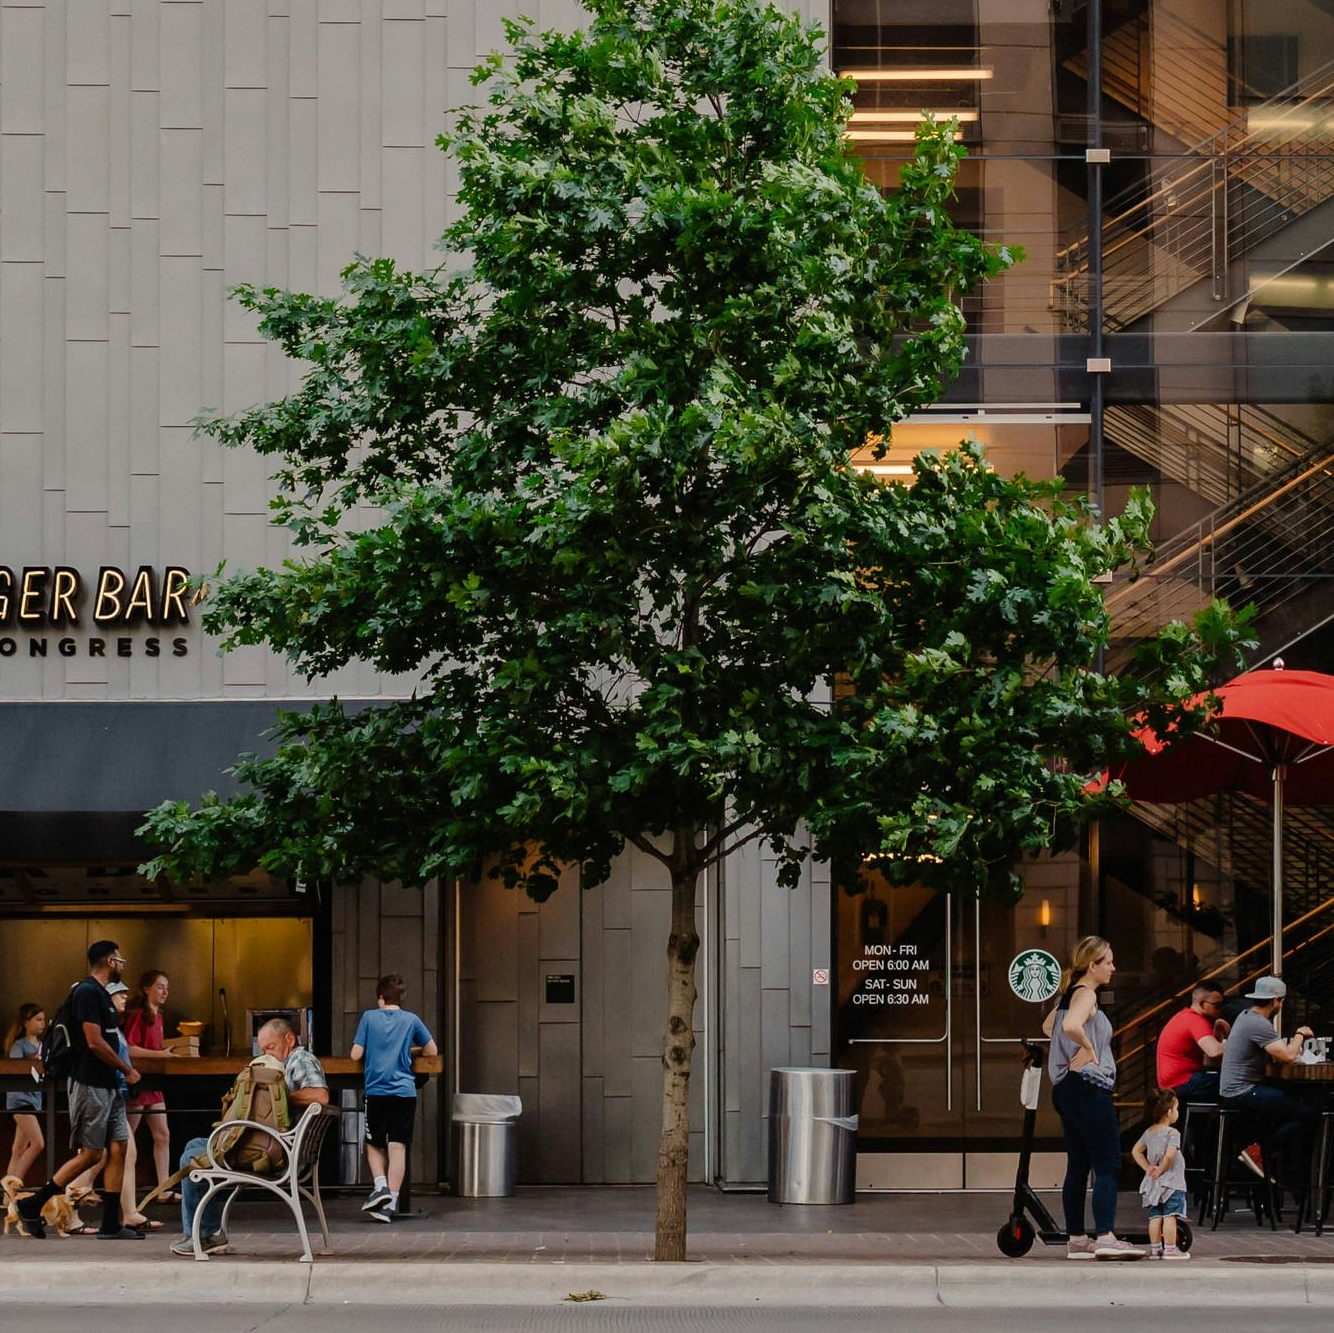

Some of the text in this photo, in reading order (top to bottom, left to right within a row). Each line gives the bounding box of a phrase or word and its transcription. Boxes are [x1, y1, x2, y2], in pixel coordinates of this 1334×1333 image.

[93, 566, 192, 626] BAR
[899, 945, 917, 955] FRI
[852, 960, 930, 970] OPEN 6:00 AM
[892, 979, 917, 989] SUN
[852, 994, 930, 1005] OPEN 6:30 AM
